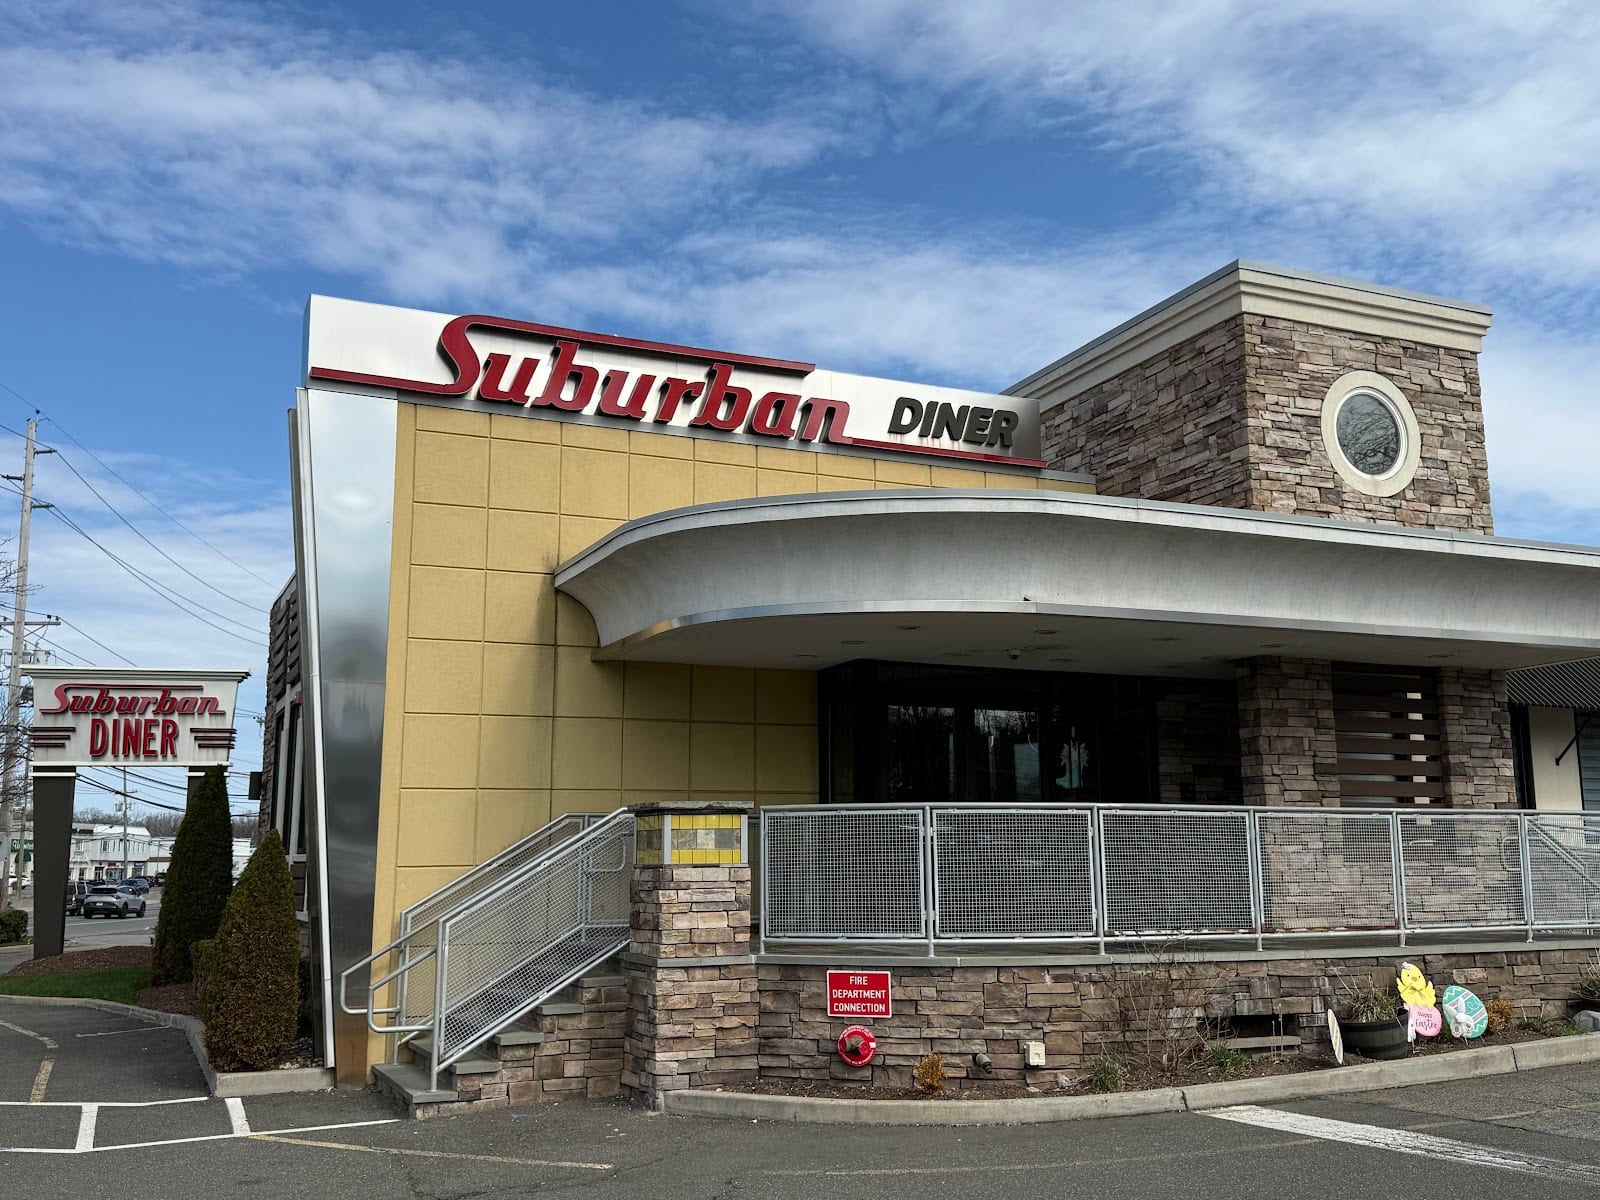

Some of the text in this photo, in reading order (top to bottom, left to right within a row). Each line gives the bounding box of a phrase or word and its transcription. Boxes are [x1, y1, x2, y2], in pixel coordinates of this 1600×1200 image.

[437, 313, 1019, 448] Suburban DINER
[39, 683, 226, 715] Suburban
[89, 718, 178, 757] DINER
[849, 976, 868, 985] FIRE
[832, 989, 886, 999] DEPARTMENT
[833, 1003, 885, 1012] CONNECTION
